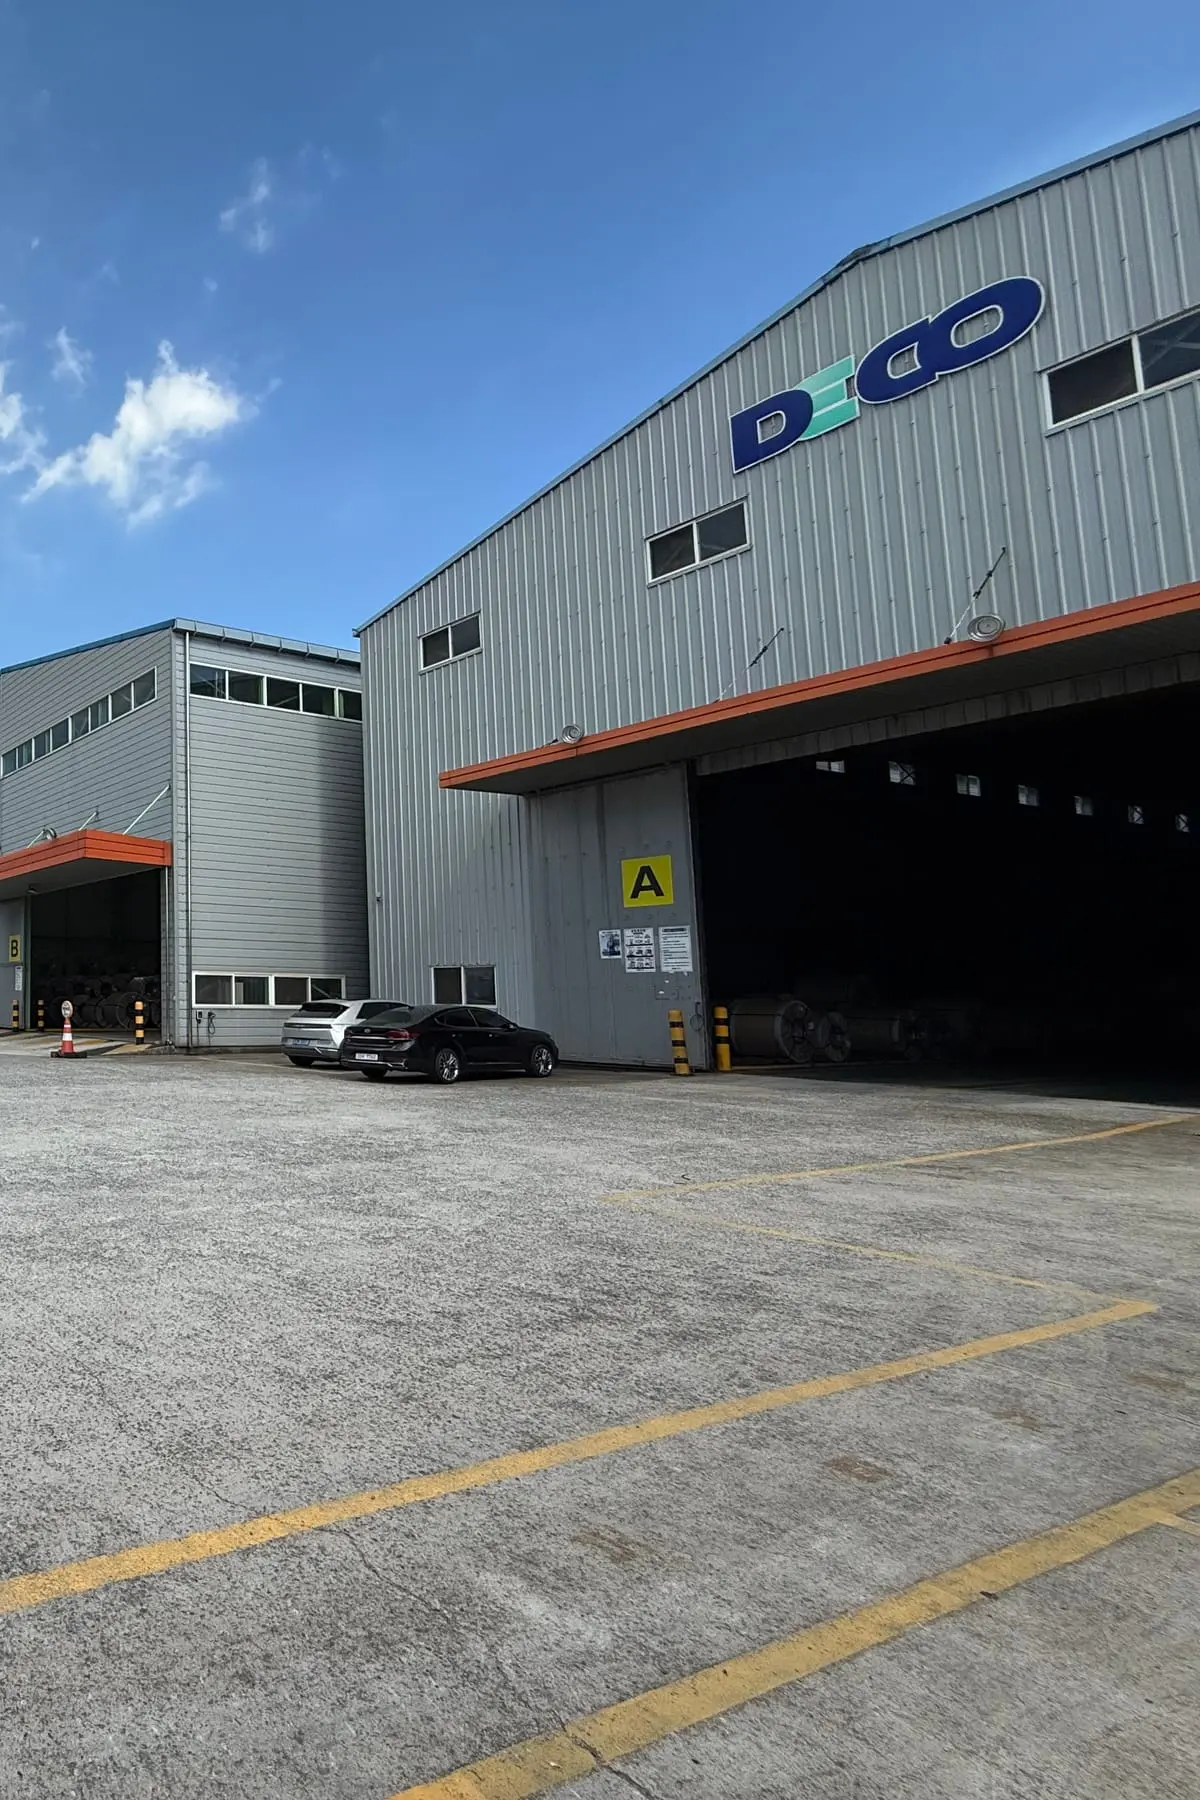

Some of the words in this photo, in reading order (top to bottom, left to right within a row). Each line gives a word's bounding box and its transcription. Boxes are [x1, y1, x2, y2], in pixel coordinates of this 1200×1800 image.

[729, 275, 1046, 474] DECO
[631, 865, 664, 899] A
[10, 939, 19, 958] B
